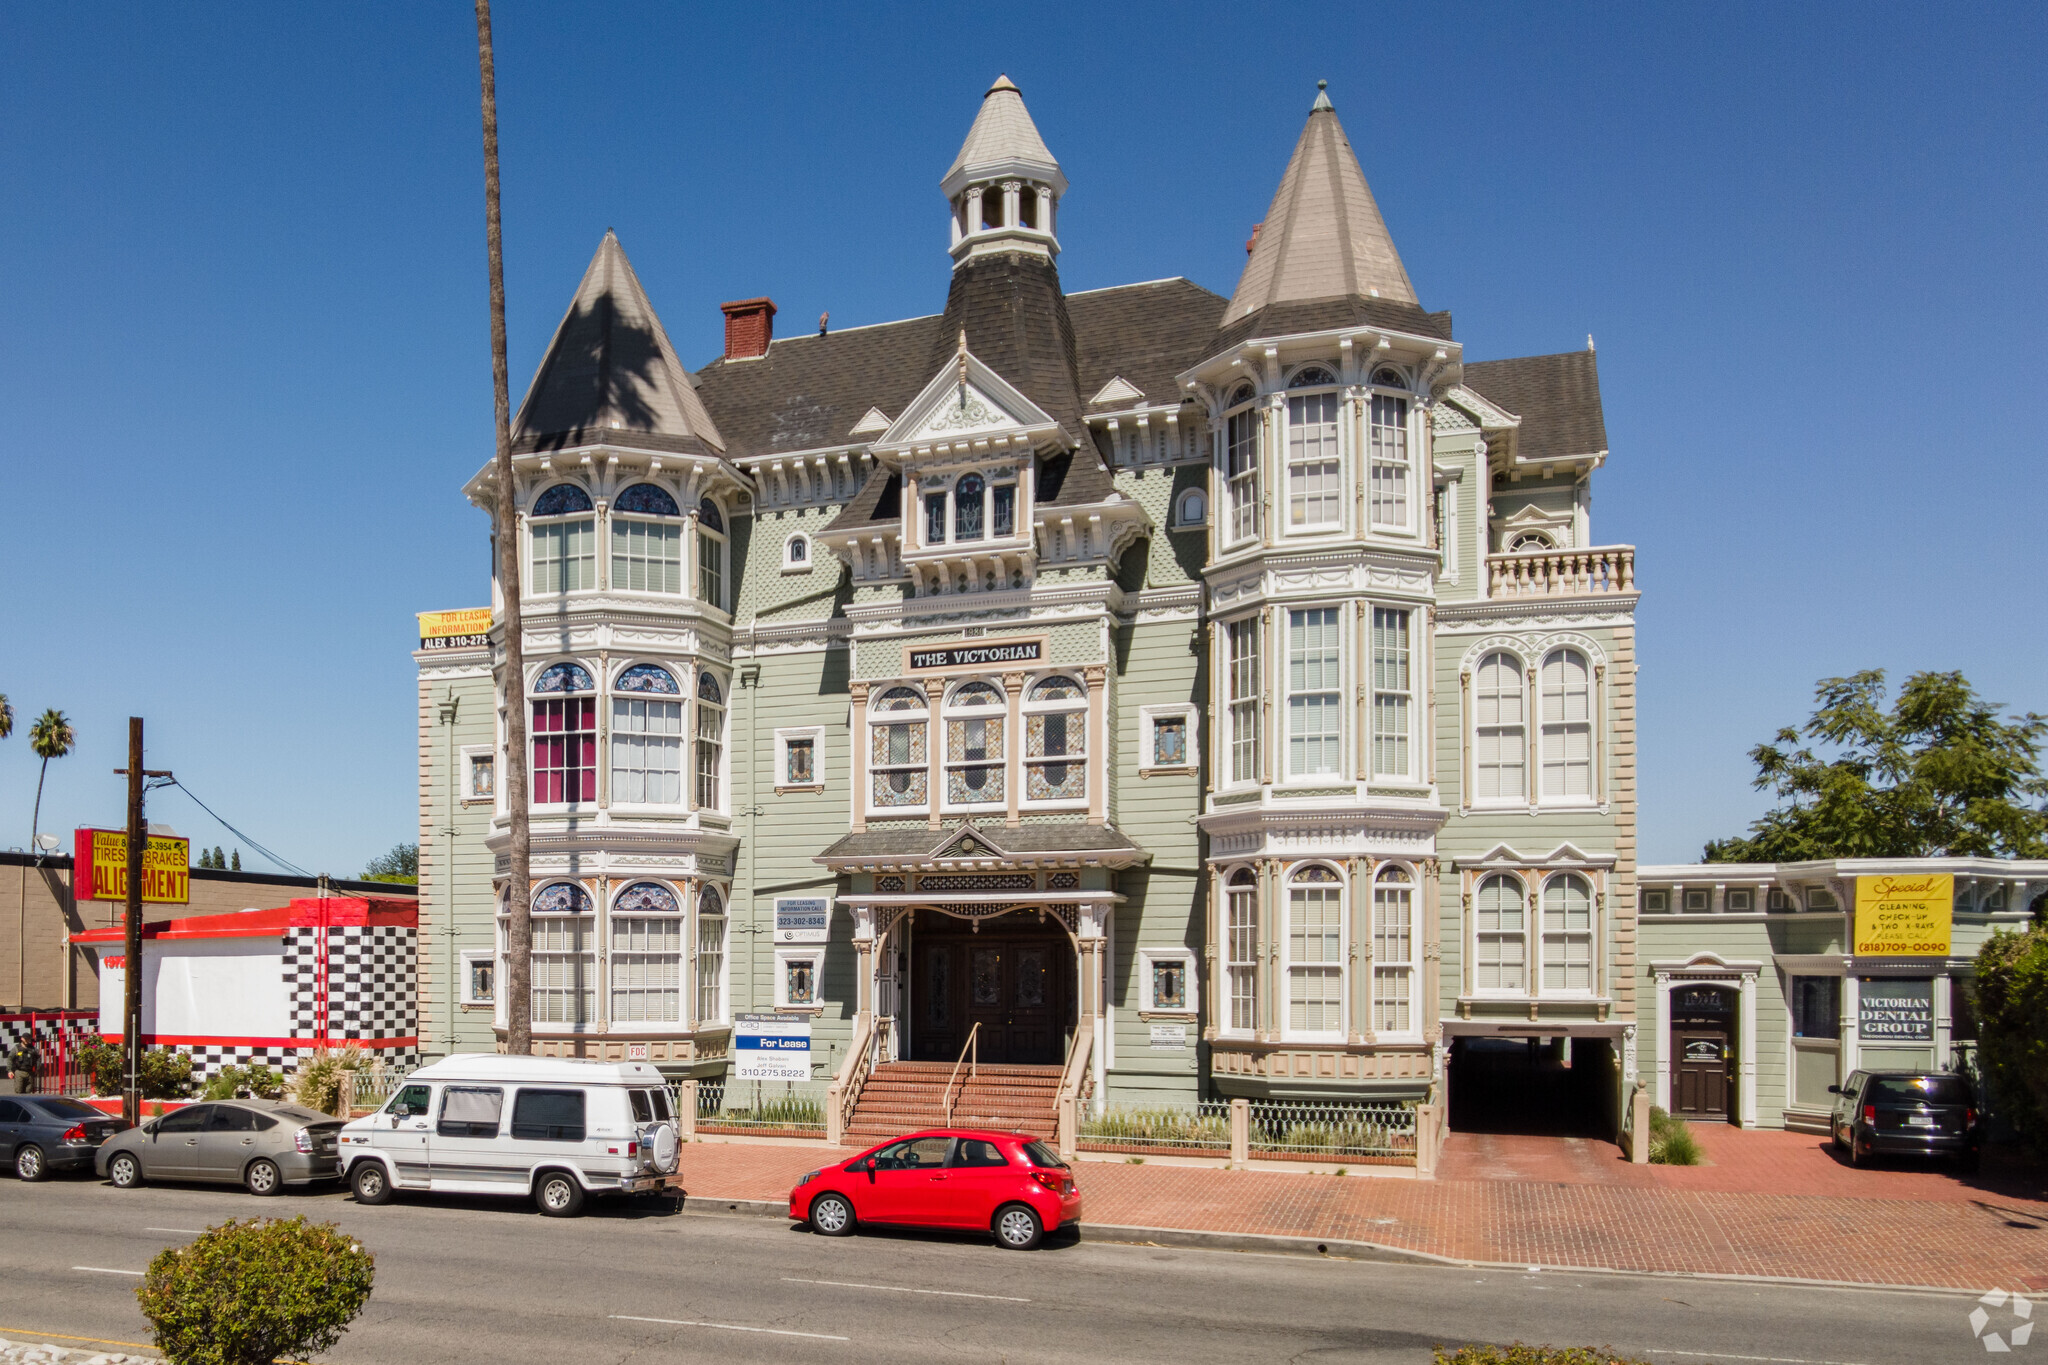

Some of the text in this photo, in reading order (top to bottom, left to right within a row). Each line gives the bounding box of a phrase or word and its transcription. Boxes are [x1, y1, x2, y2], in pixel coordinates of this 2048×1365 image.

[441, 613, 457, 622] FOR
[430, 623, 483, 635] INFORMATION
[424, 638, 446, 649] ALEX
[914, 645, 1037, 667] THE VICTORIAN
[94, 832, 120, 847] Value
[95, 847, 186, 866] TIRES BRAKES
[93, 865, 187, 898] ALIGMENT
[1874, 877, 1935, 898] Special
[1859, 943, 1946, 952] (818)709-0090
[1862, 998, 1929, 1008] VICTORIAN
[1861, 1011, 1932, 1021] DENTAL
[1865, 1023, 1927, 1033] GROUP
[760, 1038, 807, 1048] For Lease
[631, 1047, 646, 1056] FDC
[741, 1069, 805, 1077] 310.275.8222
